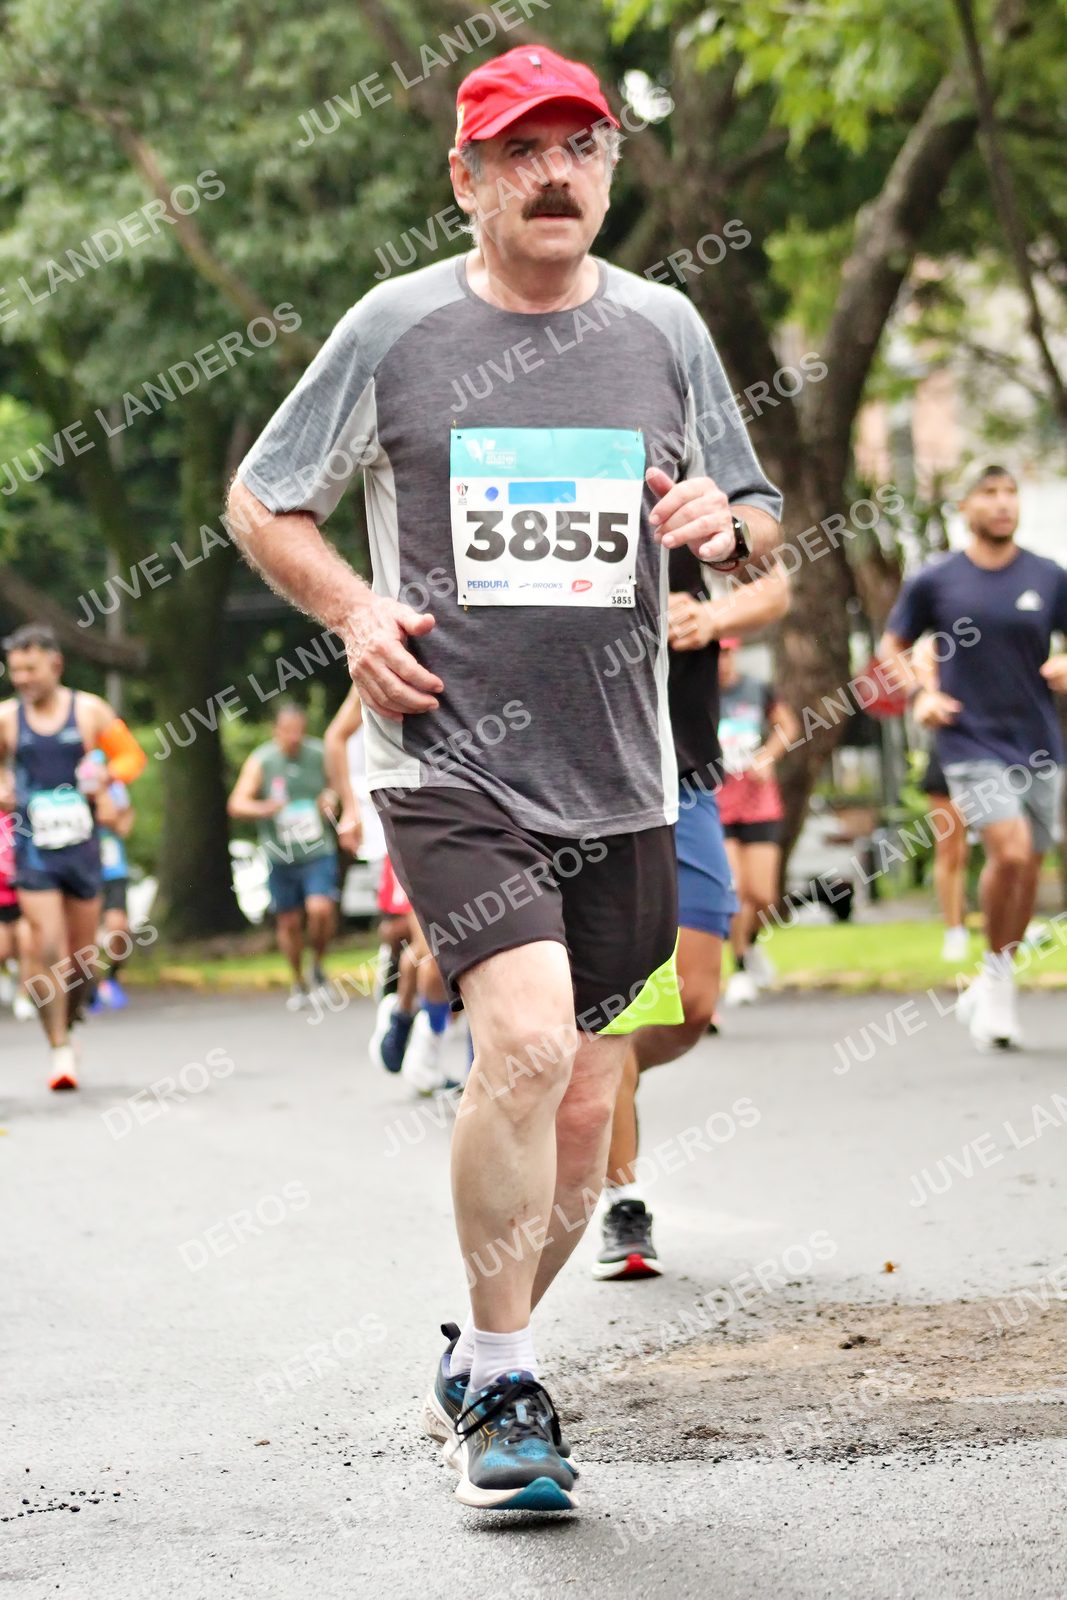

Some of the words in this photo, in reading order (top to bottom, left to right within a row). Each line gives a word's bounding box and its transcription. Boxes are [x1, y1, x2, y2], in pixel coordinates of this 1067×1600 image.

[465, 510, 629, 564] 3855
[467, 580, 509, 589] PERDURA
[611, 596, 632, 605] 3855
